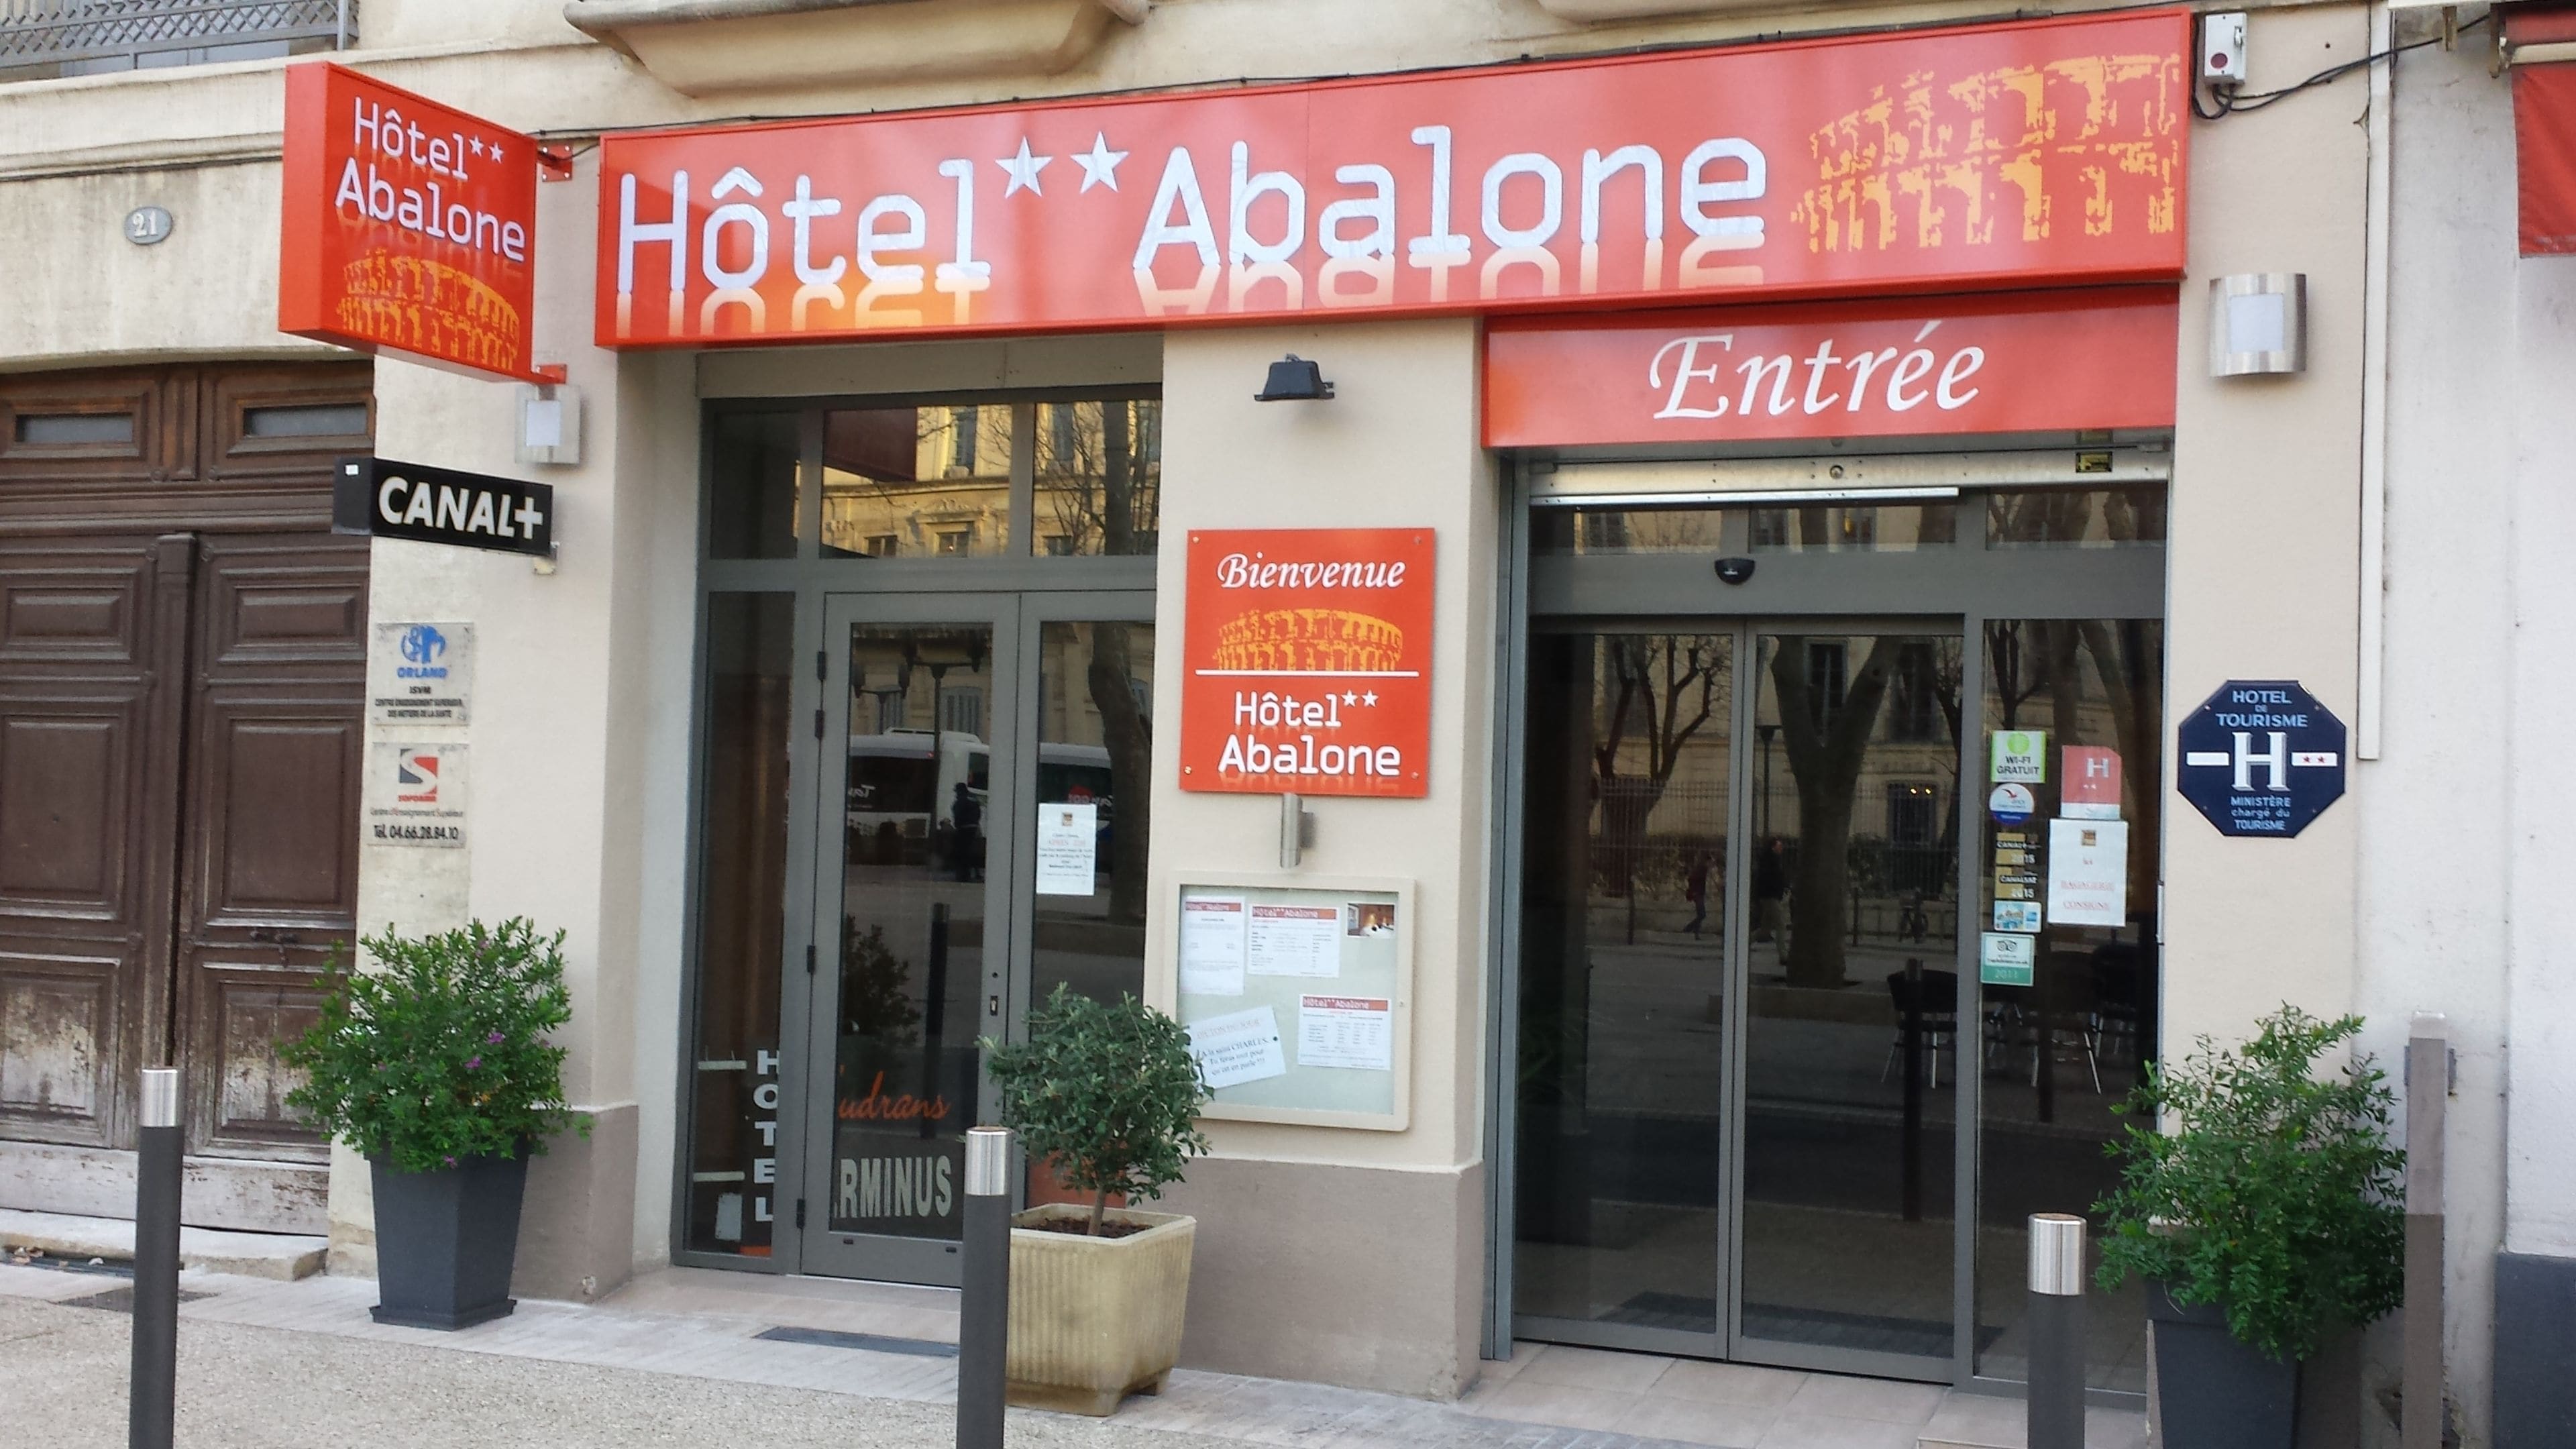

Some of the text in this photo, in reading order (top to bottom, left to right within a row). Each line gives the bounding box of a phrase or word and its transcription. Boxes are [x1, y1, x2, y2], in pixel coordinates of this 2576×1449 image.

[354, 96, 468, 180] Hôtel
[133, 207, 157, 237] 21
[335, 157, 526, 262] Abalone
[617, 125, 1767, 294] Hôtel Abalone
[1648, 320, 1984, 420] Entrée
[378, 476, 543, 540] CANAL+
[1217, 551, 1407, 589] Bienvenue
[1234, 690, 1342, 728] Hôtel
[2232, 690, 2292, 704] HOTEL
[2255, 704, 2268, 713] DE
[2216, 713, 2308, 728] TOURISME
[1217, 733, 1401, 777] Abalone
[1996, 765, 2040, 775] GRATUIT
[2005, 756, 2031, 764] WI-FI
[2086, 757, 2110, 778] H
[2231, 731, 2291, 792] H
[2231, 794, 2292, 808] MINISTÈRE
[2231, 807, 2290, 820] chargé du
[2234, 819, 2286, 831] TOURISME
[834, 1155, 953, 1220] RMINUS
